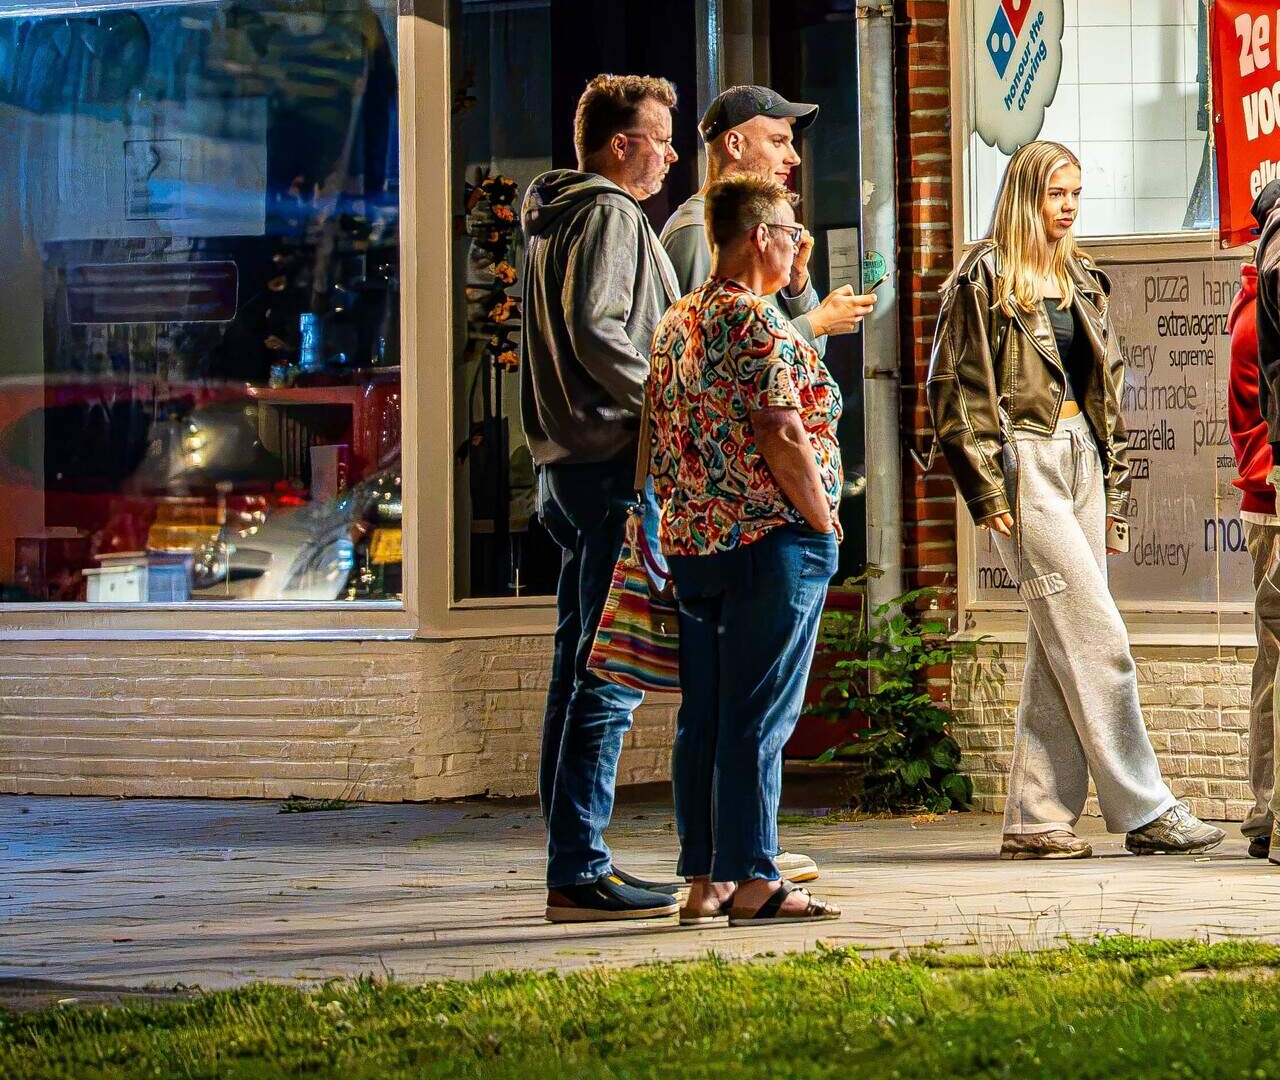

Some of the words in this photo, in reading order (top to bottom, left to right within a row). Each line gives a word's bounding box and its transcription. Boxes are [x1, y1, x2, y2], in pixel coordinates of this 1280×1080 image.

[1004, 41, 1031, 111] honour
[1029, 10, 1044, 44] the
[1234, 13, 1271, 78] 2e
[1017, 39, 1047, 112] craving
[1144, 269, 1189, 313] pizza
[1157, 310, 1230, 344] extravaganz
[1169, 349, 1214, 371] supreme
[1126, 419, 1175, 451] zzarella
[1193, 411, 1229, 456] pizz
[1134, 534, 1190, 576] delivery
